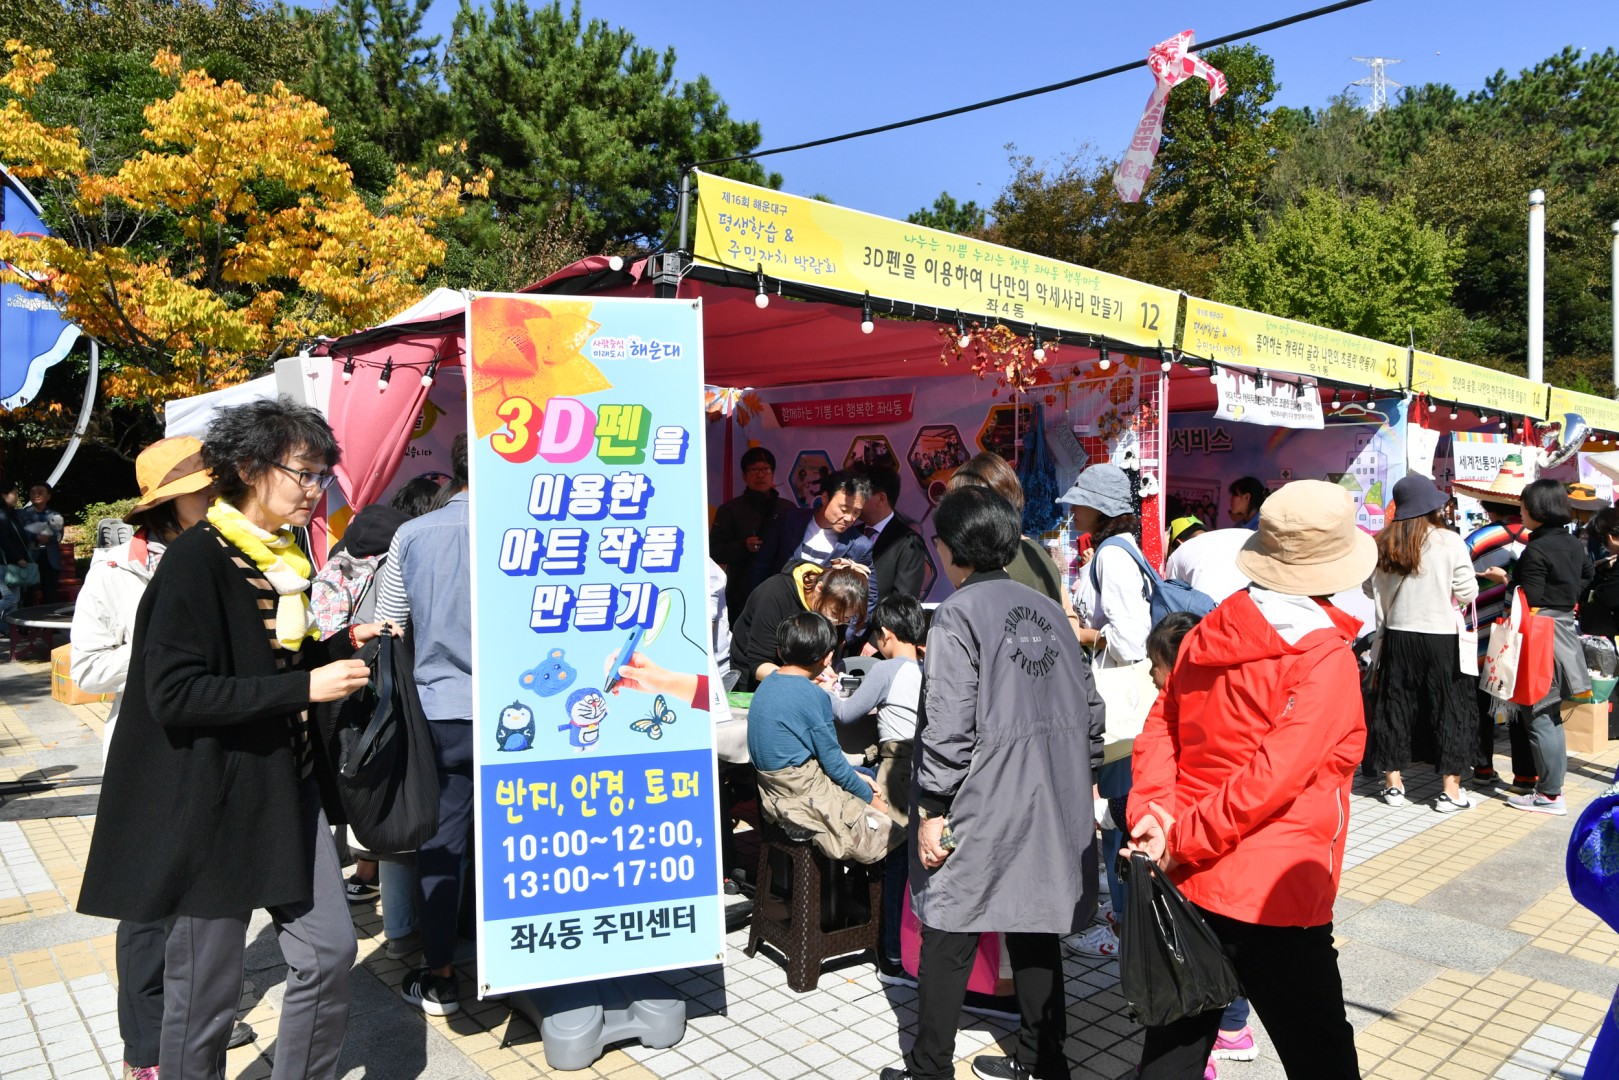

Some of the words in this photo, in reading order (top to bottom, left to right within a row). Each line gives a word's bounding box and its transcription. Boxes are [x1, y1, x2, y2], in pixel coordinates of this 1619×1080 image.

[721, 192, 750, 208] 제16회
[753, 199, 788, 217] 해운대구
[718, 213, 778, 243] 평생학습
[785, 228, 794, 242] &
[728, 240, 787, 264] 주민자치
[794, 255, 836, 275] 박람회
[904, 235, 940, 252] 나누는
[946, 243, 968, 259] 기쁨
[972, 249, 1006, 267] 누리는
[1009, 256, 1030, 275] 행복
[1034, 264, 1060, 280] 좌4동
[1064, 269, 1101, 291] 행복마을
[863, 246, 917, 280] 3D펜을
[924, 258, 982, 293] 이용하여
[990, 272, 1030, 302] 나만의
[1036, 281, 1085, 314] 악세사리
[1090, 294, 1123, 322] 만들기
[1140, 301, 1161, 331] 12
[592, 339, 625, 349] 사람중심
[593, 350, 625, 358] 미래도시
[629, 340, 680, 360] 해운대
[1256, 333, 1282, 356] 좋아하는
[1284, 340, 1305, 360] 캐릭터
[1306, 344, 1320, 362] 골라
[1321, 347, 1340, 366] 나만의
[1341, 353, 1358, 369] 초콜릿
[1359, 356, 1376, 373] 만들기
[1386, 357, 1397, 378] 13
[781, 406, 812, 422] 함께하는
[814, 404, 832, 420] 기쁨
[834, 405, 844, 417] 더
[846, 402, 875, 419] 행복한
[877, 400, 903, 416] 좌4동
[1533, 391, 1540, 408] 14
[1166, 426, 1233, 455] 서비스
[528, 471, 655, 521] 이용한
[498, 527, 589, 576] 아트
[599, 525, 685, 573] 작품
[529, 582, 659, 634] 만들기
[1004, 606, 1052, 636] FRONTPAGE
[496, 778, 564, 824] 반지,
[571, 770, 635, 817] 안경,
[645, 768, 700, 805] 토퍼
[502, 820, 702, 863] 10:00~12:00,
[502, 855, 695, 900] 13:00~17:00
[510, 917, 584, 954] 좌4동
[592, 904, 697, 944] 주민센터
